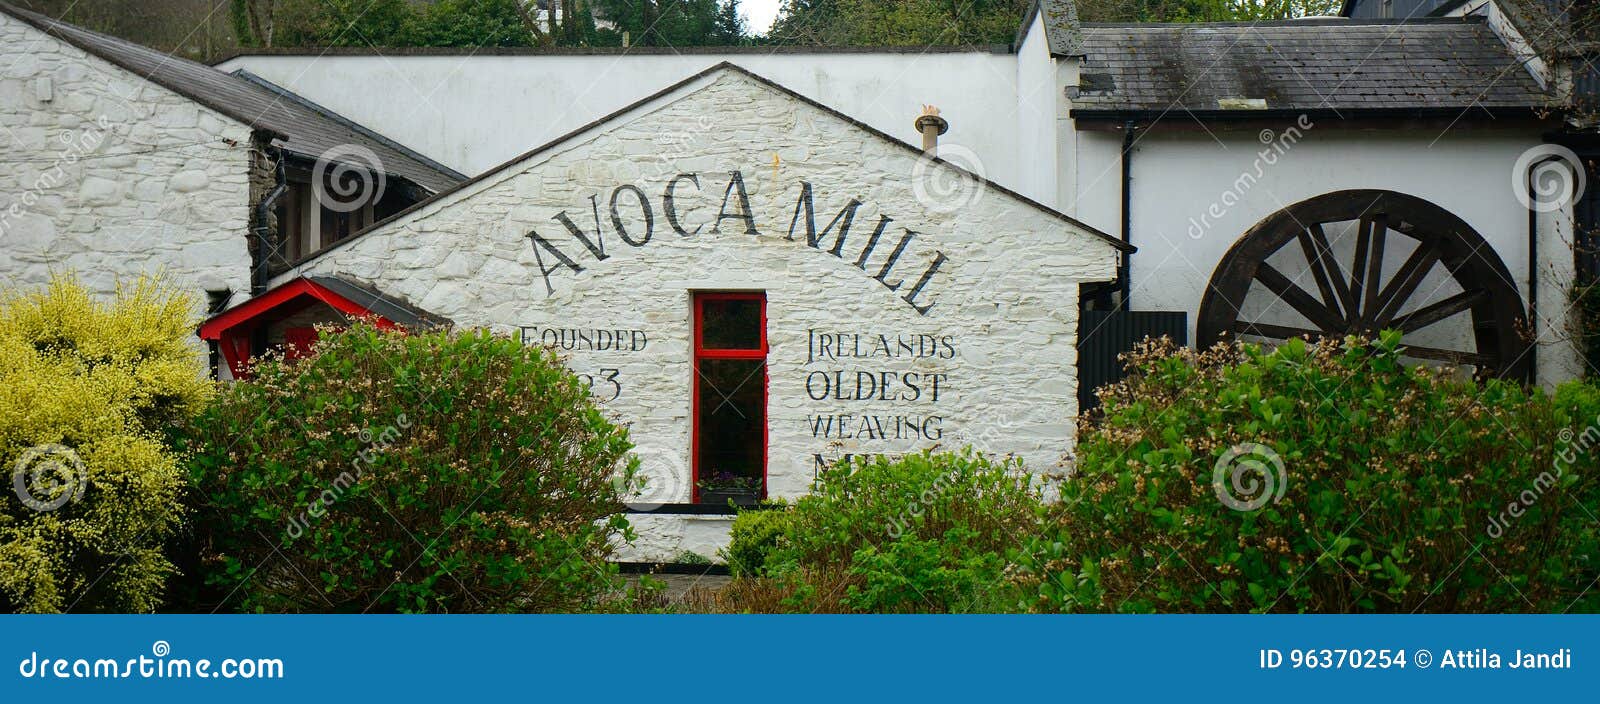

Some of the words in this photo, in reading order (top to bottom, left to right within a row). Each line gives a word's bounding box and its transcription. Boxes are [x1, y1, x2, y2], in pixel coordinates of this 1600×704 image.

[525, 170, 760, 297] AVOCA
[783, 180, 950, 316] MILL
[519, 326, 648, 351] FOUNDED
[807, 330, 956, 364] IRELANDS
[805, 370, 947, 402] OLDEST
[807, 414, 943, 440] WEAVING
